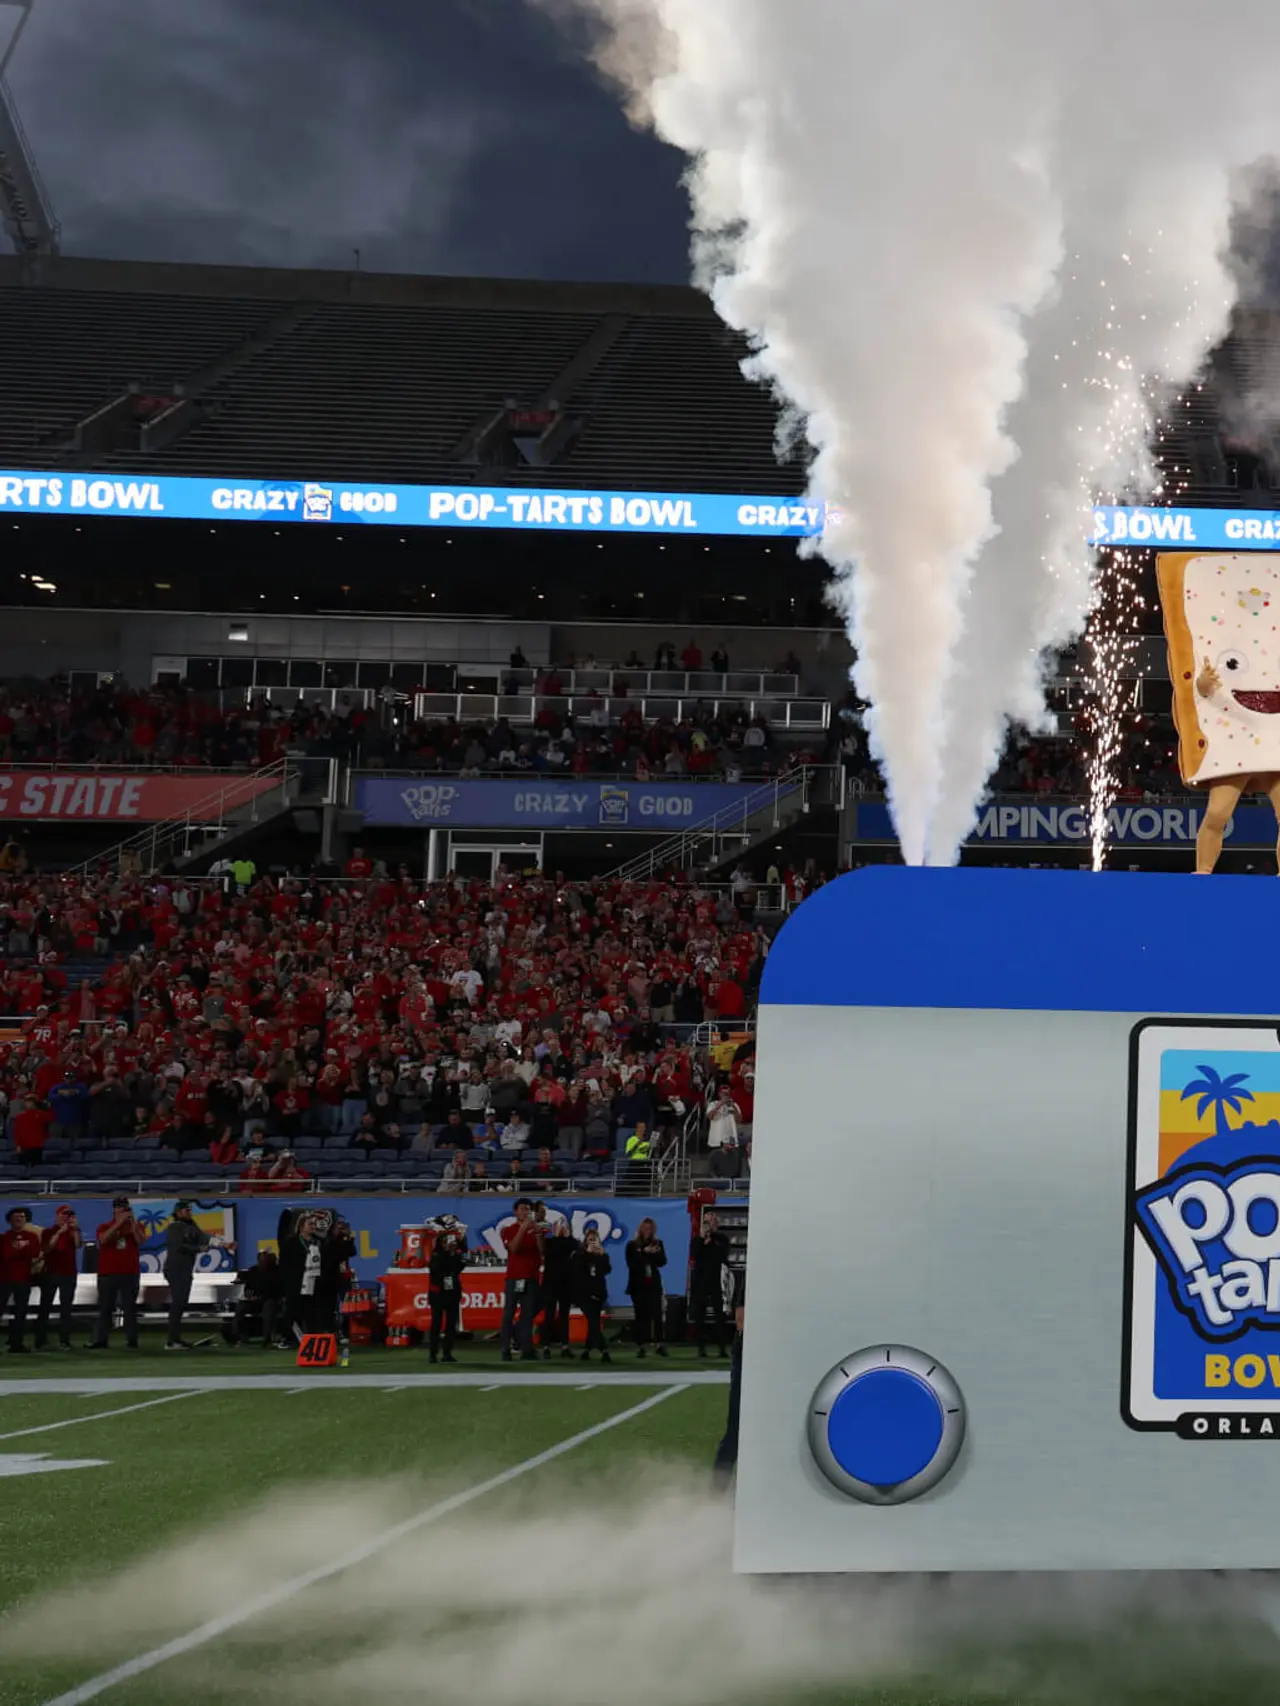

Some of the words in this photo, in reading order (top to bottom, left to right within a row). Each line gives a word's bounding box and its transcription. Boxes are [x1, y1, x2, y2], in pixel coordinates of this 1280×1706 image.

[70, 480, 164, 511] BOWL
[211, 487, 299, 512] CRAZY
[428, 492, 603, 525] POP-TARTS
[610, 497, 697, 527] BOWL
[737, 504, 819, 527] CRAZY
[20, 776, 149, 816] STATE
[513, 792, 588, 814] CRAZY
[639, 795, 693, 817] GOOD
[406, 1234, 421, 1250] G
[300, 1336, 331, 1362] 40
